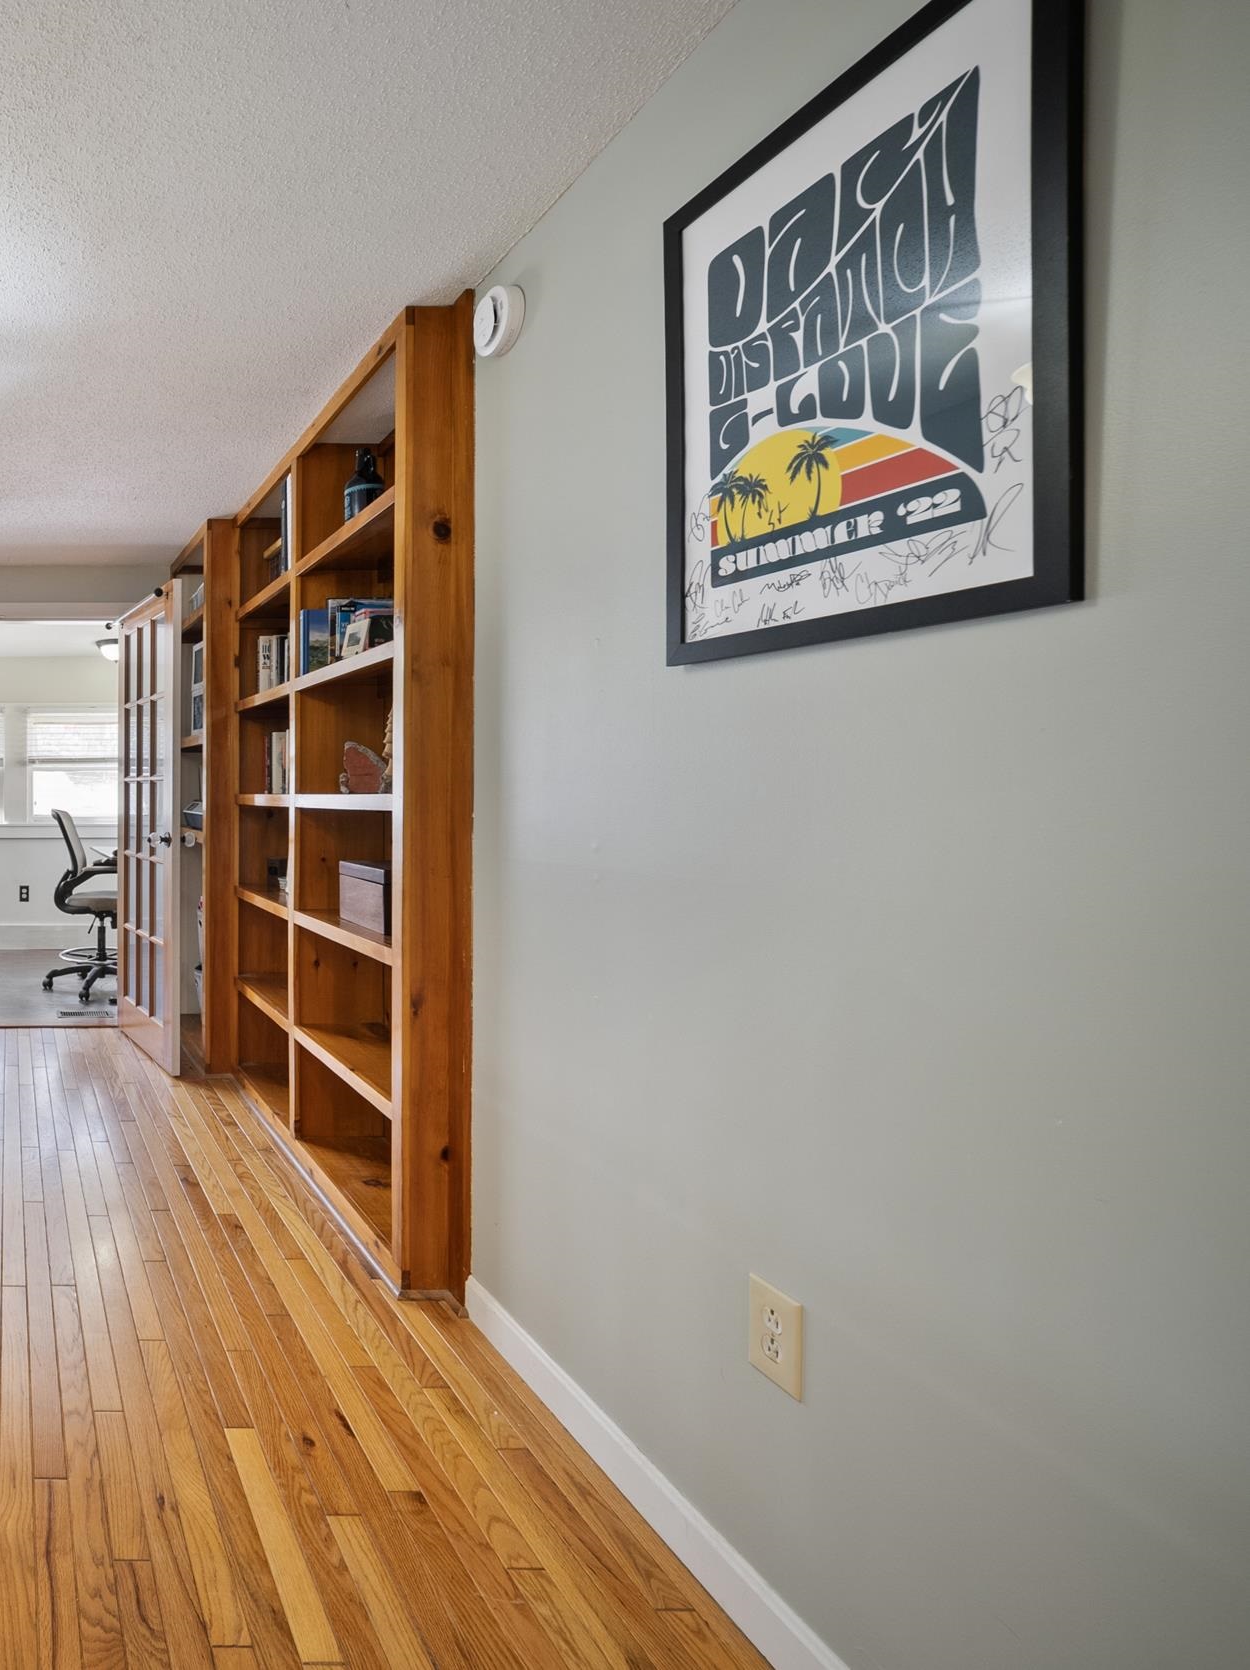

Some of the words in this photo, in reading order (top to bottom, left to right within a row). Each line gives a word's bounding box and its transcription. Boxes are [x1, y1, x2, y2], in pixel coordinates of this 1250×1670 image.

[708, 65, 982, 406] DISPATCH
[709, 278, 984, 481] G-LOVE
[718, 510, 885, 577] SUMMER
